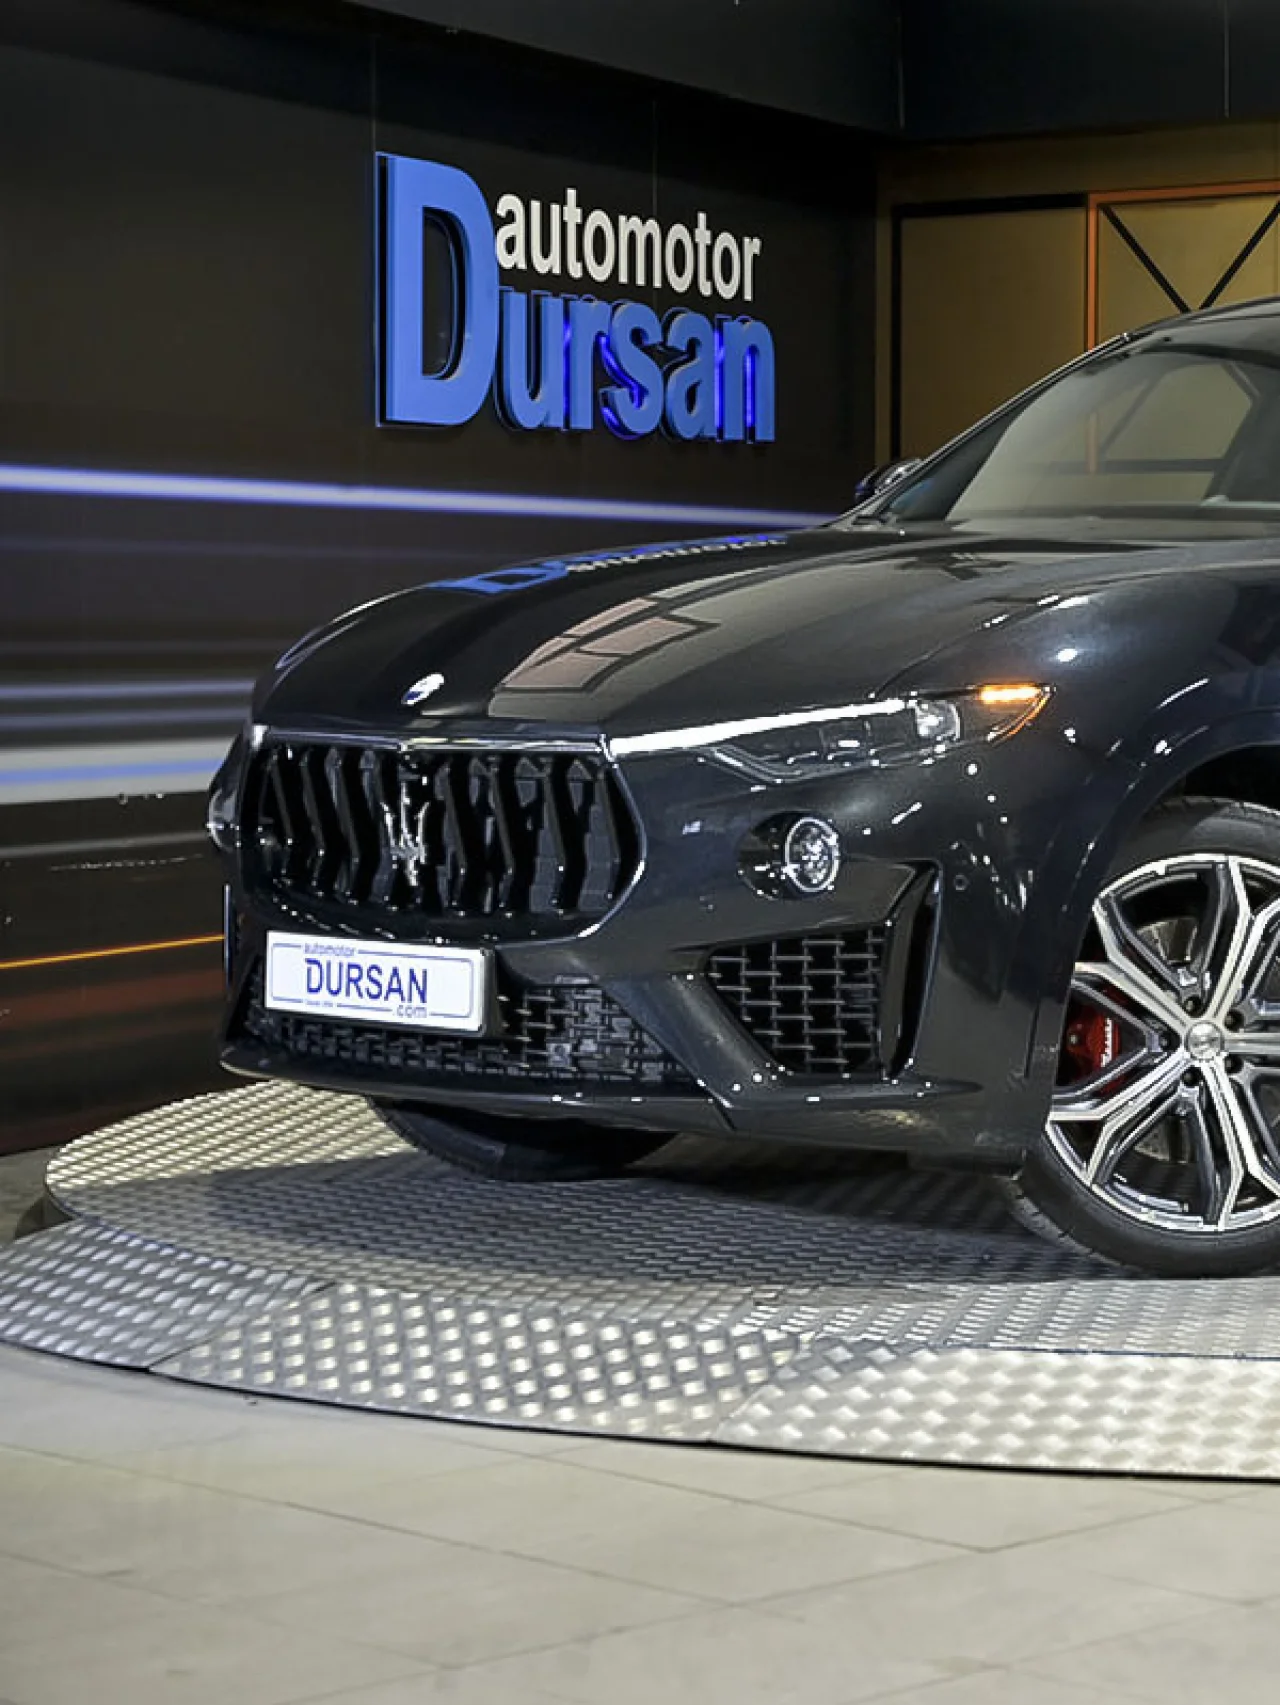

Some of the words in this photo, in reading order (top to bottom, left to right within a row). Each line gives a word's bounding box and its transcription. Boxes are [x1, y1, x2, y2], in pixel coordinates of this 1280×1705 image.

[496, 187, 762, 301] automotor
[376, 151, 776, 443] Dursan
[304, 942, 355, 957] automotor
[304, 957, 428, 1004] DURSAN
